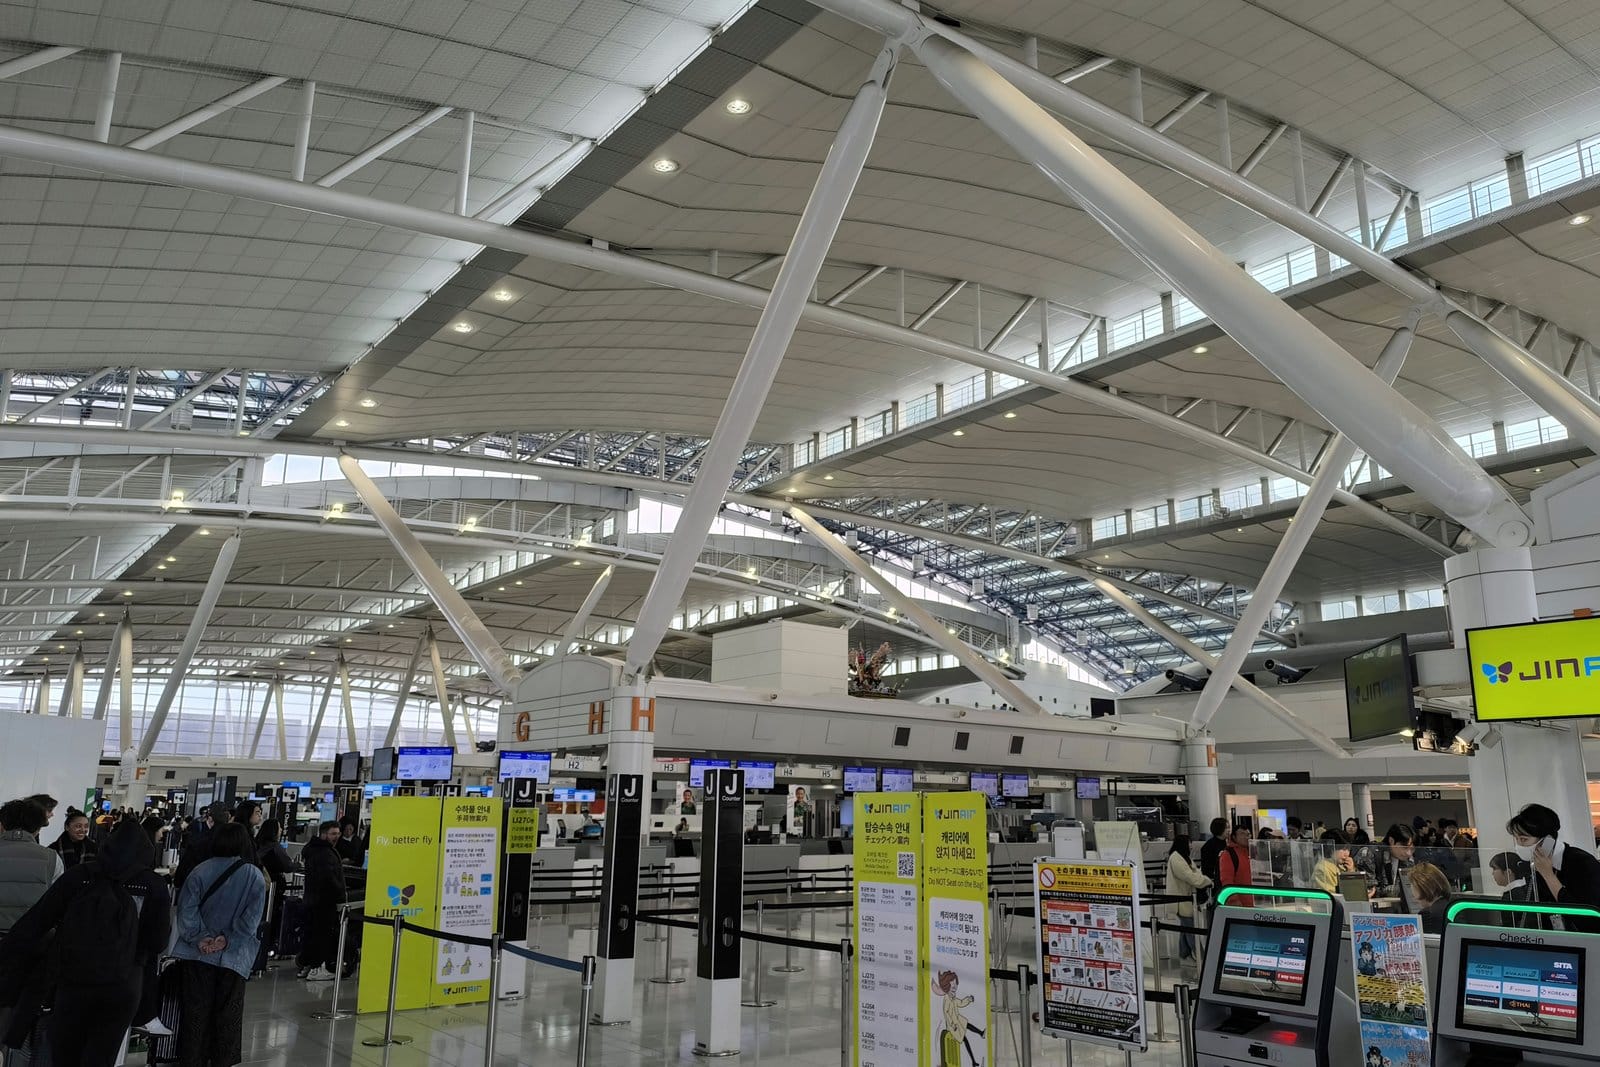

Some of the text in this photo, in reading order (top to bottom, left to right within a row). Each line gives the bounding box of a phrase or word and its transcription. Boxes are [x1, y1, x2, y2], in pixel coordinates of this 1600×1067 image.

[588, 701, 604, 735] H
[632, 697, 655, 731] H
[516, 711, 530, 742] G
[568, 761, 580, 769] H2
[664, 764, 674, 772] H3
[136, 767, 147, 780] F
[519, 780, 530, 798] J
[624, 778, 636, 797] J
[706, 773, 713, 795] J
[725, 773, 737, 795] J
[349, 790, 359, 801] H
[477, 805, 491, 813] 안내
[865, 822, 910, 833] 탑승수속 안내
[393, 835, 419, 844] better
[422, 836, 433, 845] fly
[865, 836, 910, 845] チェックイン案内
[941, 832, 969, 844] 캐리어에
[936, 847, 975, 860] 앉지 마세요!
[1253, 913, 1286, 923] Check-in
[1499, 933, 1544, 944] Check-in
[1553, 961, 1573, 970] SITA
[1517, 1001, 1531, 1009] THAI
